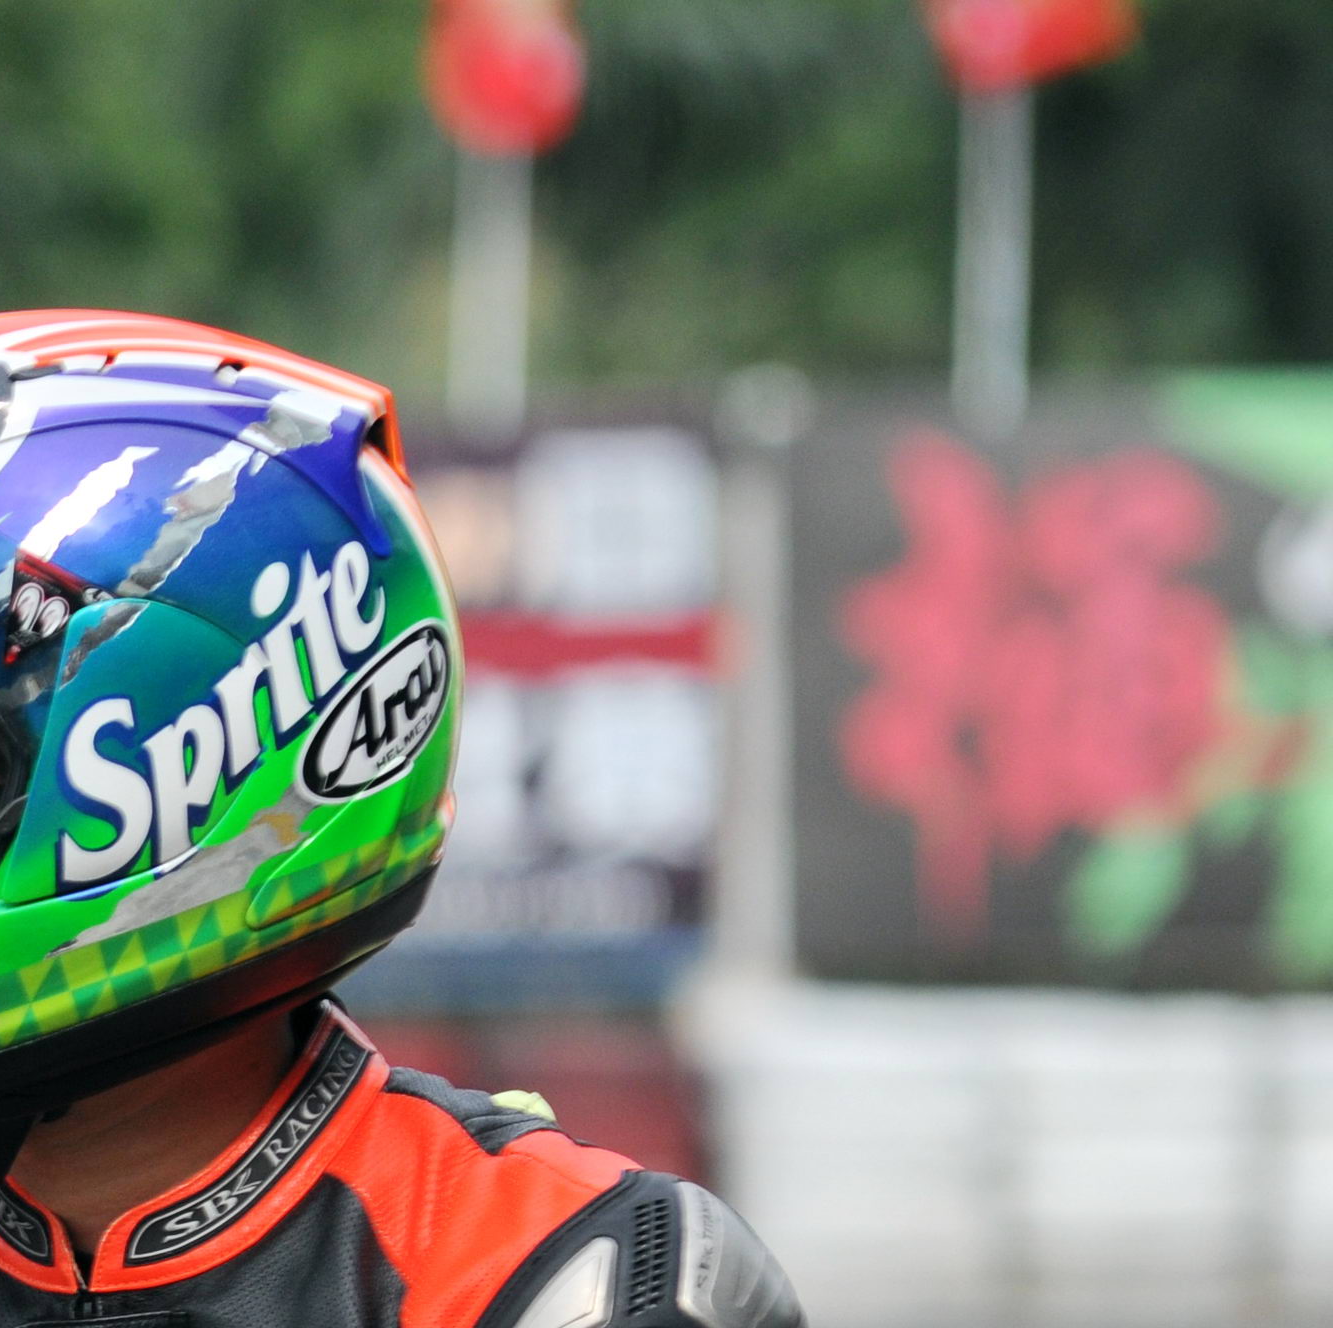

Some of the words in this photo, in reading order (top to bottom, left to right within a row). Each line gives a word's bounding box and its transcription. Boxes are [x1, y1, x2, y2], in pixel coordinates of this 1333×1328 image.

[59, 538, 386, 882] Sprite
[323, 628, 444, 790] Arai
[162, 1167, 262, 1244] SBK
[263, 1045, 357, 1167] RACING
